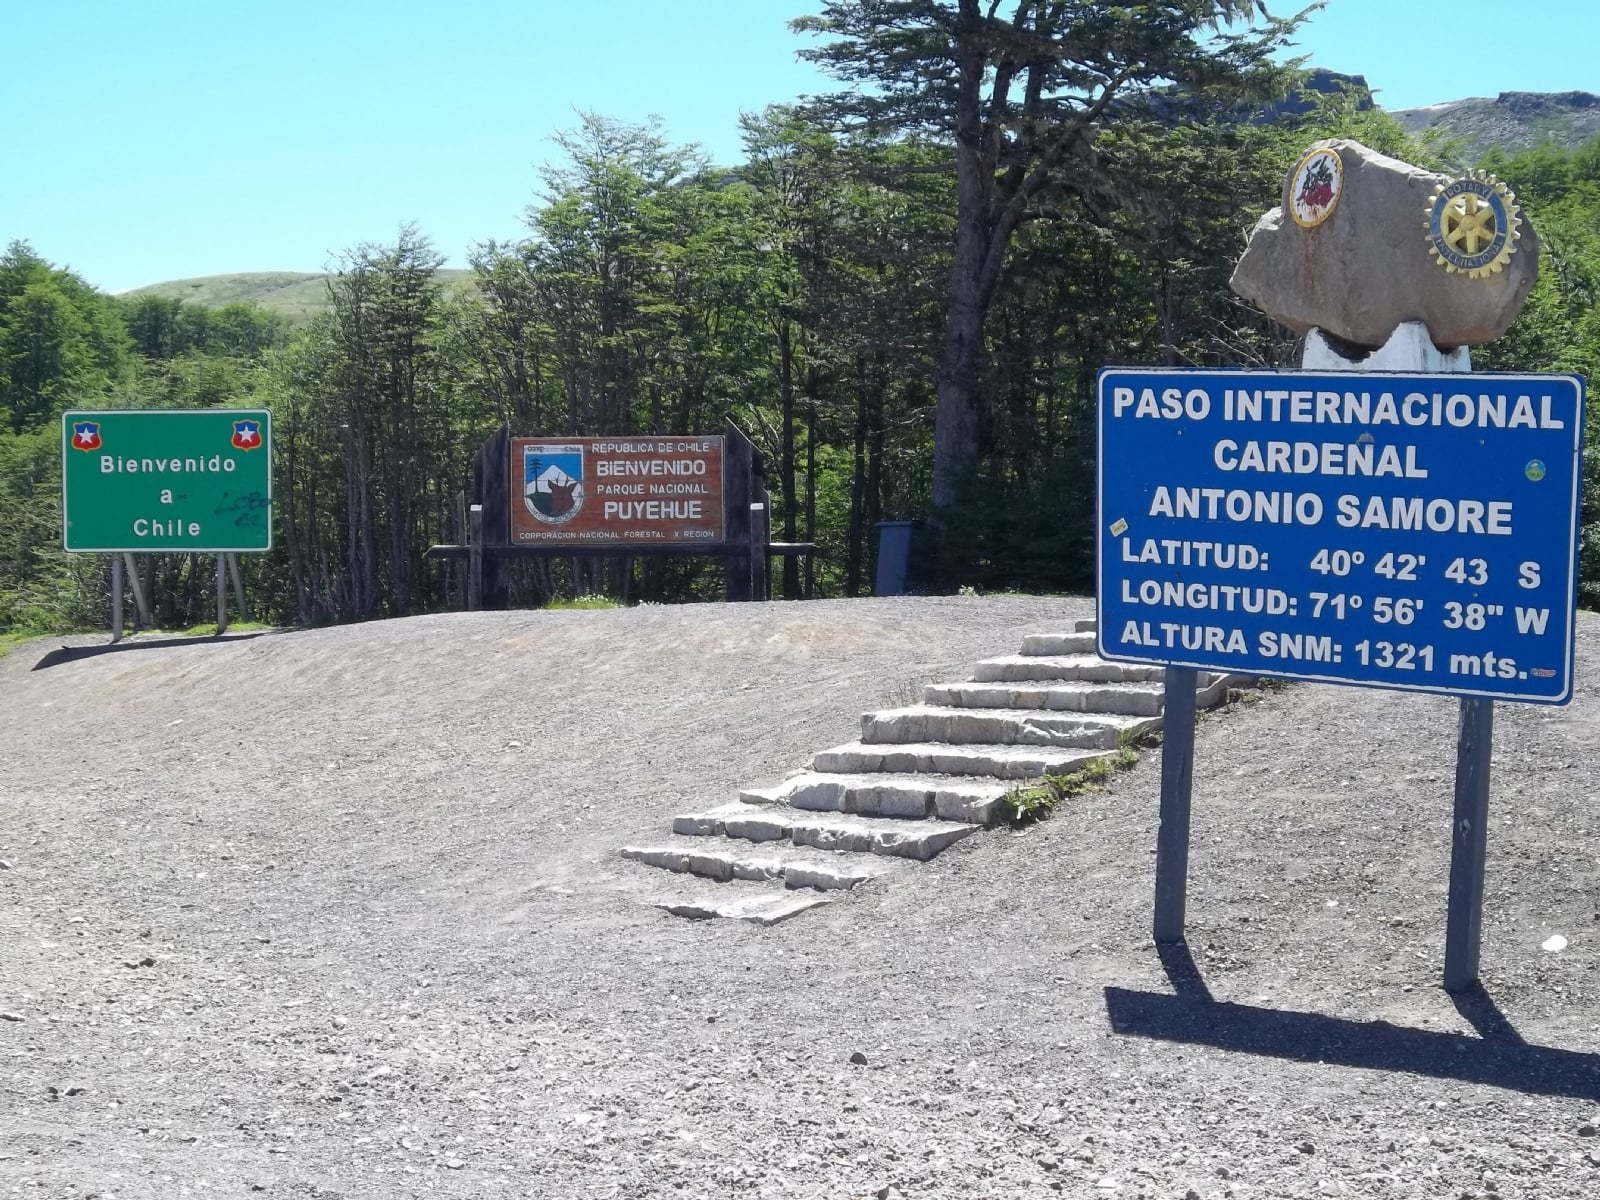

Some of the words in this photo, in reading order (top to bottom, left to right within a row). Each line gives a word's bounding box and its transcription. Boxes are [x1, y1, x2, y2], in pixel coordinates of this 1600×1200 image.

[1113, 387, 1211, 421] PASO
[1223, 389, 1565, 430] INTERNACIONAL
[591, 442, 654, 453] REPUBLICA
[658, 442, 674, 453] DE
[677, 442, 710, 453] CHILE
[100, 455, 236, 473] Bienvenido
[596, 459, 706, 477] BIENVENIDO
[1213, 439, 1429, 479] CARDENAL
[160, 488, 173, 504] a
[597, 484, 645, 496] PARQUE
[650, 483, 708, 495] NACIONAL
[604, 500, 703, 520] PUYEHUE
[1149, 486, 1324, 526] ANTONIO
[1336, 494, 1513, 536] SAMORE
[133, 518, 201, 537] Chile
[519, 532, 577, 540] CORPORACION
[579, 531, 620, 539] NACIONAL
[624, 530, 666, 538] FORESTAL
[683, 530, 714, 538] REGION
[1121, 537, 1269, 571] LATITUD:
[1374, 553, 1426, 581] 42'
[1445, 558, 1489, 586] 43
[1518, 561, 1542, 589] S
[1121, 580, 1298, 616] LONGITUD:
[1373, 597, 1424, 625] 56'
[1443, 602, 1504, 631] 38"
[1515, 606, 1550, 636] W
[1121, 621, 1249, 655] ALTURA
[1258, 632, 1343, 663] SNM:
[1354, 640, 1434, 672] 1321
[1450, 649, 1529, 680] mts.
